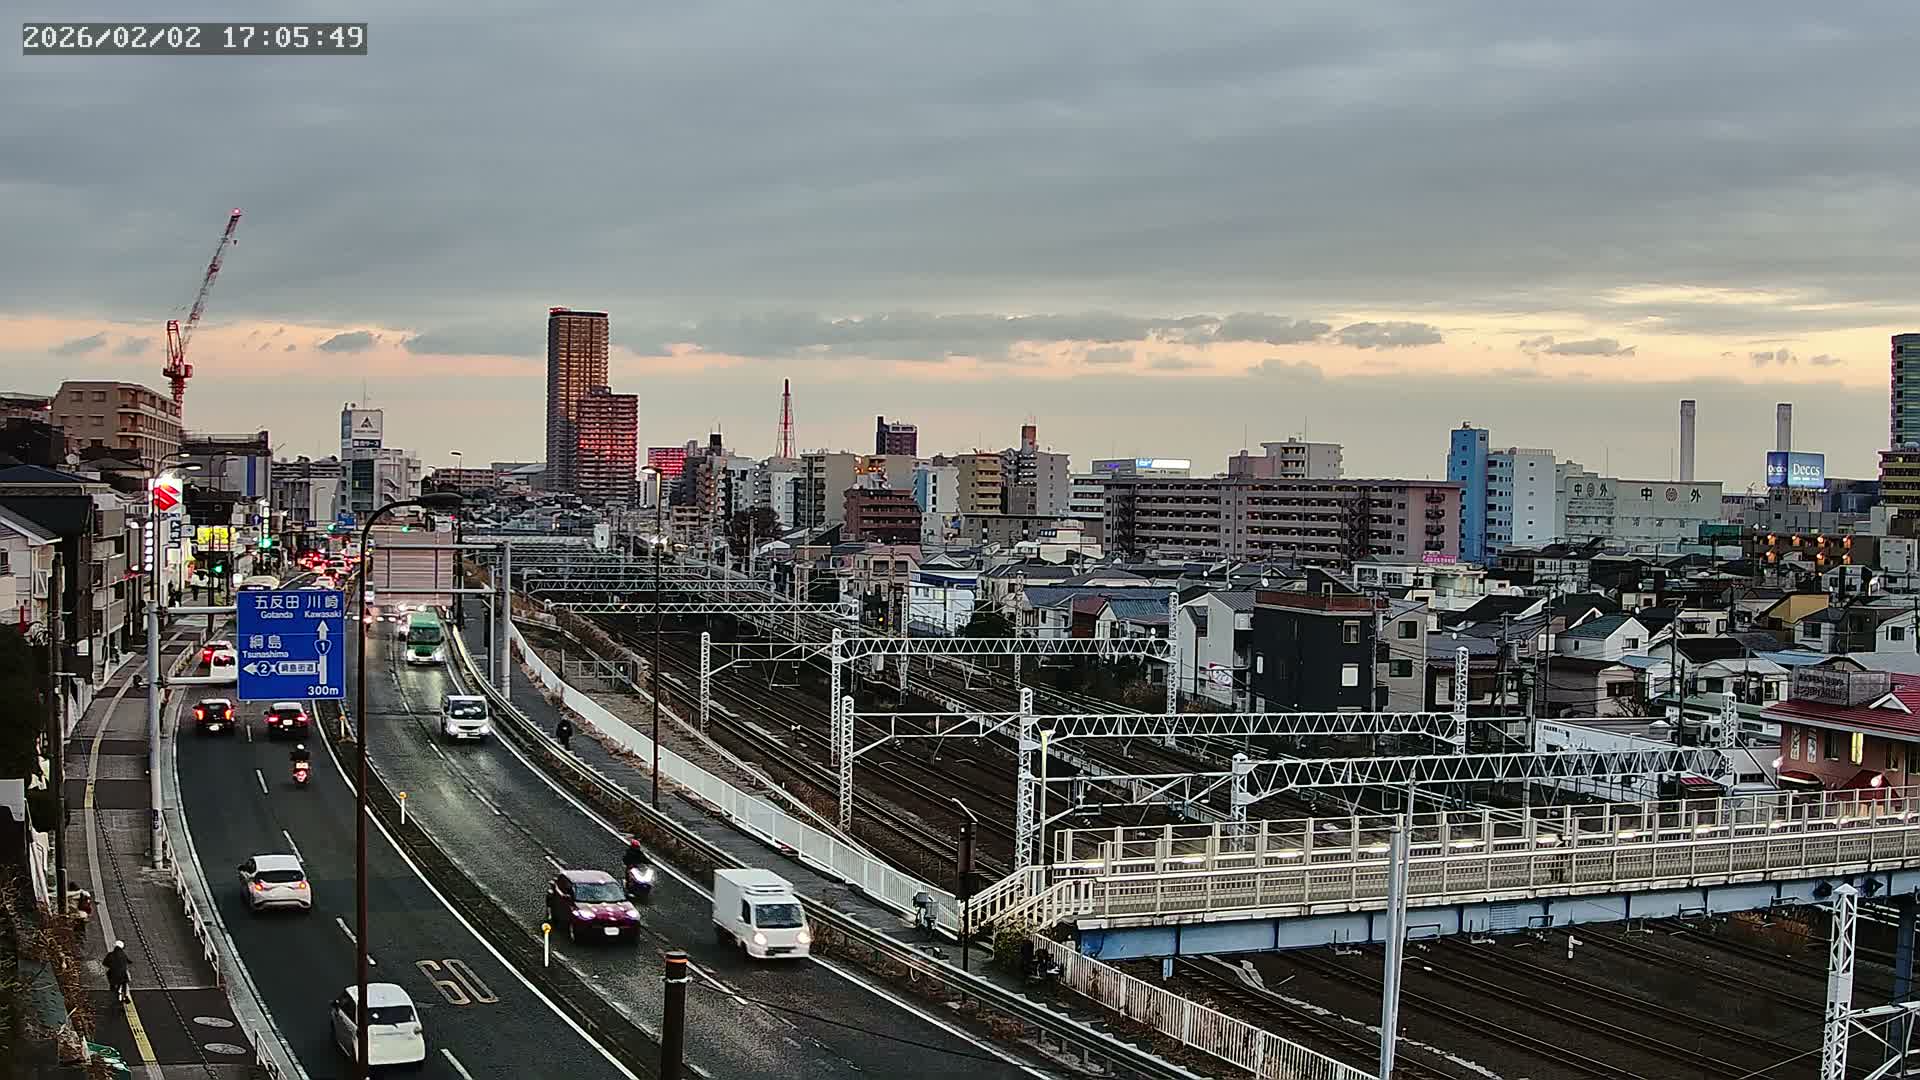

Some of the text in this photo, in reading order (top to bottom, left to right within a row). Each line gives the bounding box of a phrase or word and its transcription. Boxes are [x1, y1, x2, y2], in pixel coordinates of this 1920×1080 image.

[1641, 487, 1701, 503] 中 外
[254, 595, 339, 609] 五反田 川崎
[260, 610, 342, 619] Gotanda Kawasaki
[249, 634, 281, 649] 綱島
[320, 642, 326, 651] 1
[241, 650, 290, 659] Tsunashima
[260, 663, 268, 674] 2
[307, 685, 339, 696] 300m
[415, 959, 499, 1005] 60
